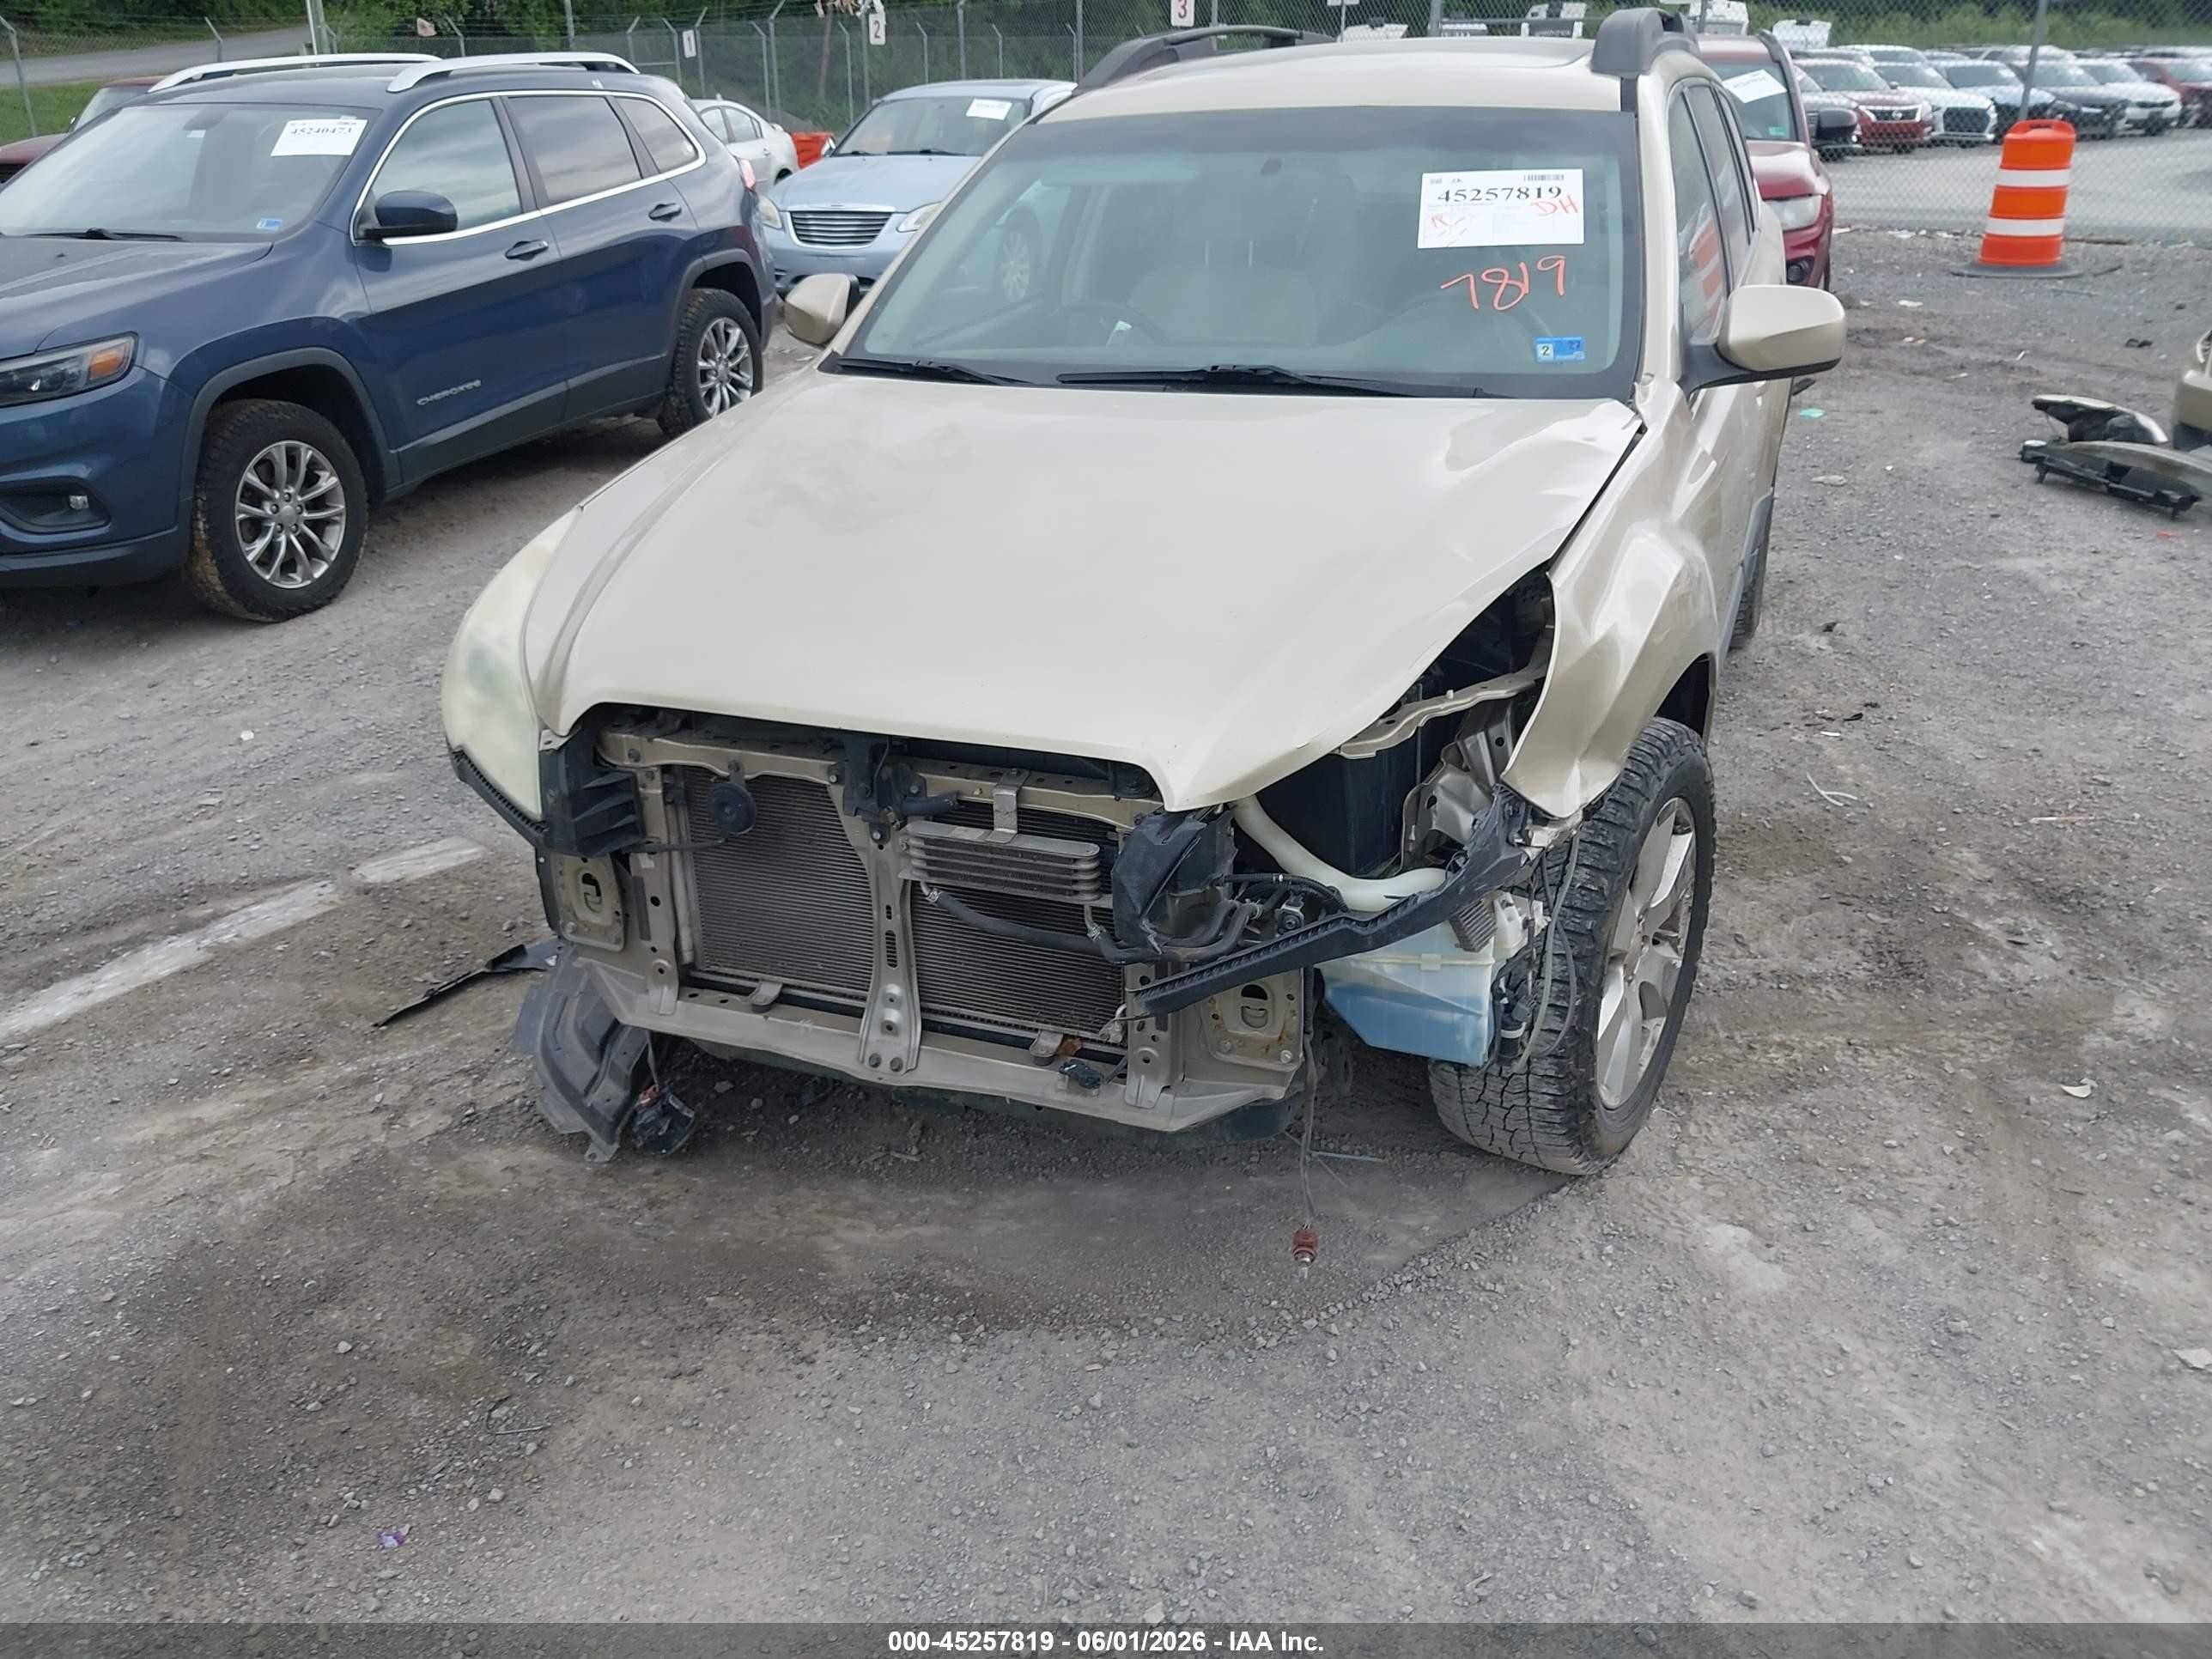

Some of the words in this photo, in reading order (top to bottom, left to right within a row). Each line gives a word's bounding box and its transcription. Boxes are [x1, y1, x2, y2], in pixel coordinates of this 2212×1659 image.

[1178, 0, 1188, 19] 3
[873, 20, 881, 40] 2
[1437, 185, 1562, 203] 45257819
[1530, 195, 1579, 216] DH
[1440, 255, 1566, 311] 7819
[1541, 344, 1551, 356] 2
